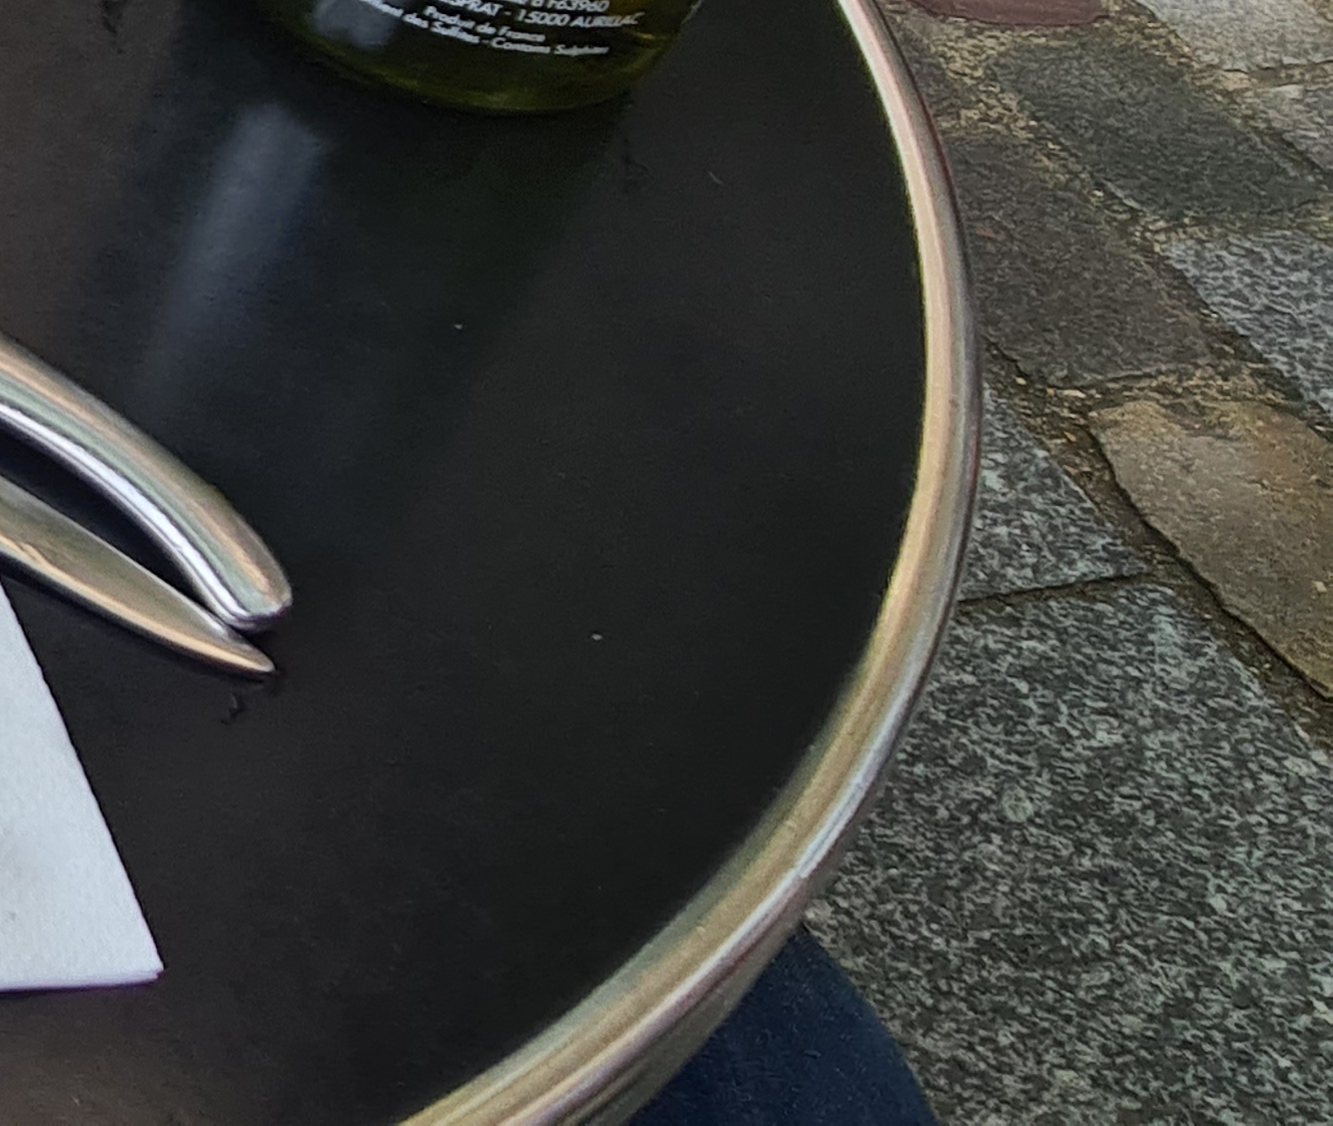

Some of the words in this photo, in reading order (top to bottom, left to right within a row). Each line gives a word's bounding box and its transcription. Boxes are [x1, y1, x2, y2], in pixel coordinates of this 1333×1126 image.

[403, 13, 430, 29] des
[491, 37, 551, 55] Contains
[424, 5, 476, 30] Produit
[476, 22, 497, 35] de
[498, 26, 546, 42] France
[516, 9, 571, 26] 15000
